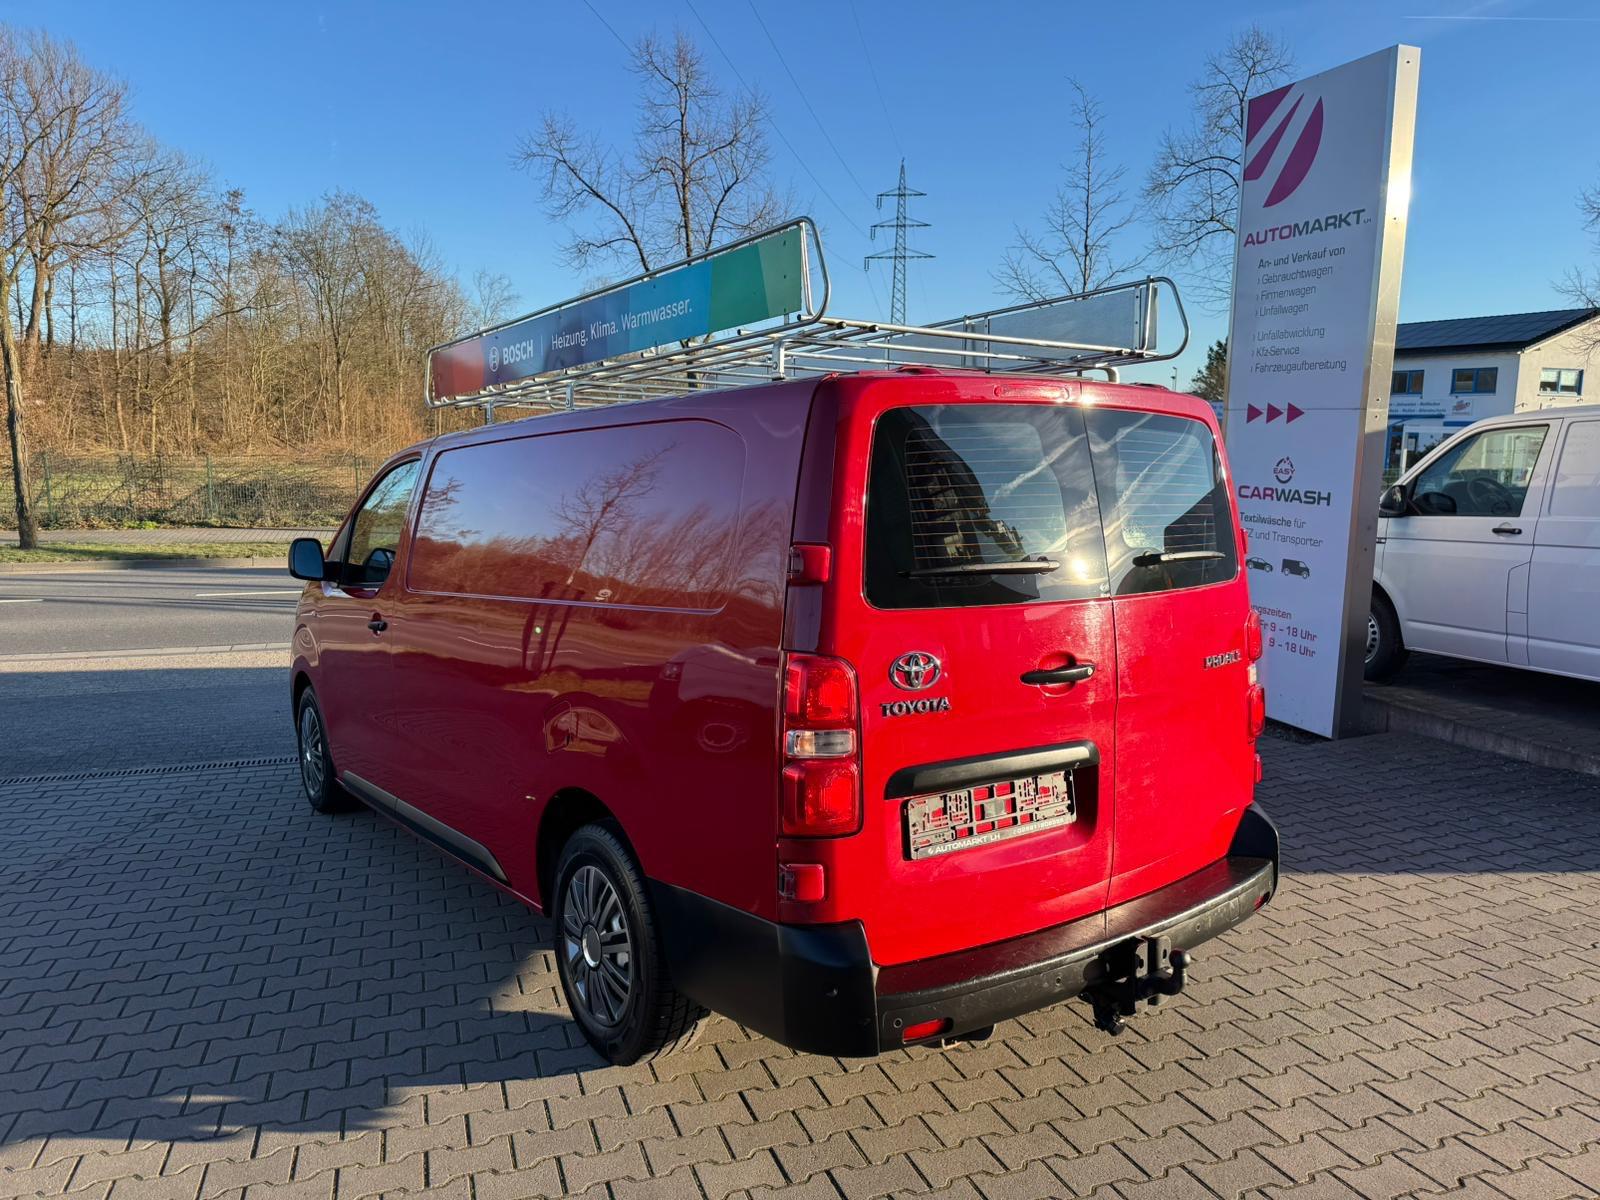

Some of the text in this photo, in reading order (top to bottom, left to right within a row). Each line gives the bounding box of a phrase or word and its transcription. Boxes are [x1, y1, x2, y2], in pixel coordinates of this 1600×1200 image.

[1243, 208, 1366, 248] AUTOMARKT
[1258, 246, 1346, 269] An- und Verkauf von
[1261, 265, 1334, 285] Gebrauchtwagen
[1260, 285, 1317, 301] Firmenwagen
[1259, 303, 1309, 317] Unfallwagen
[502, 298, 693, 366] BOSCH Heizung. Klima. Warmwasser.
[1257, 326, 1325, 342] Unfallabwicklung
[1255, 345, 1300, 358] Kfz-Service
[1254, 359, 1347, 375] Fahrzeugaufbereitung
[1273, 466, 1296, 476] EASY
[1238, 485, 1332, 507] CARWASH
[1240, 511, 1307, 530] Textilwäsche für
[1255, 530, 1270, 541] und
[1271, 530, 1324, 548] Transporter
[1270, 622, 1277, 633] 9
[1286, 625, 1299, 638] 18
[1300, 628, 1318, 642] Uhr
[1268, 637, 1276, 648] 9
[1284, 641, 1298, 654] 18
[1299, 644, 1317, 658] Uhr
[880, 697, 951, 718] TOYOTA
[935, 832, 1001, 854] AUTOMARKT LH
